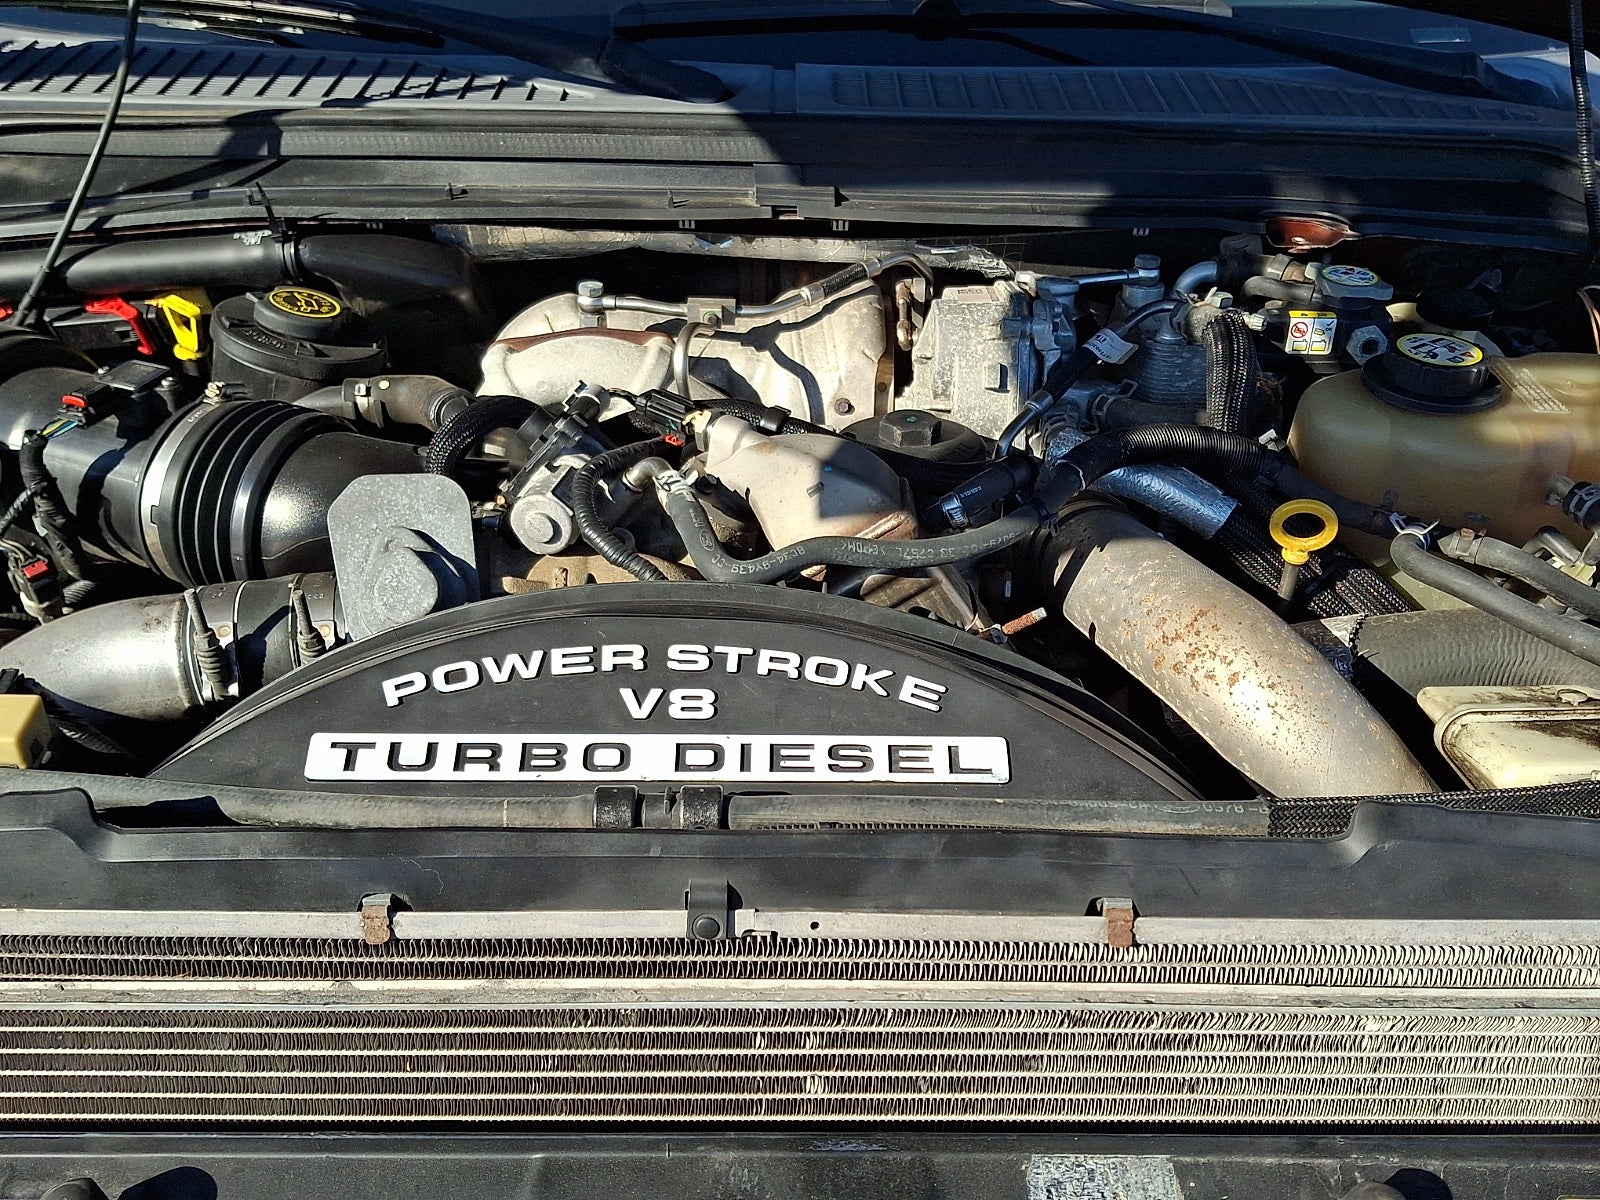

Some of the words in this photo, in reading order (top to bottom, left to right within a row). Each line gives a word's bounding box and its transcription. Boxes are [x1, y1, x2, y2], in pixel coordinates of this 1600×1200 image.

[381, 643, 648, 707] POWER
[666, 643, 949, 713] STROKE
[619, 687, 718, 721] V8
[330, 741, 632, 773] TURBO
[675, 742, 994, 775] DIESEL
